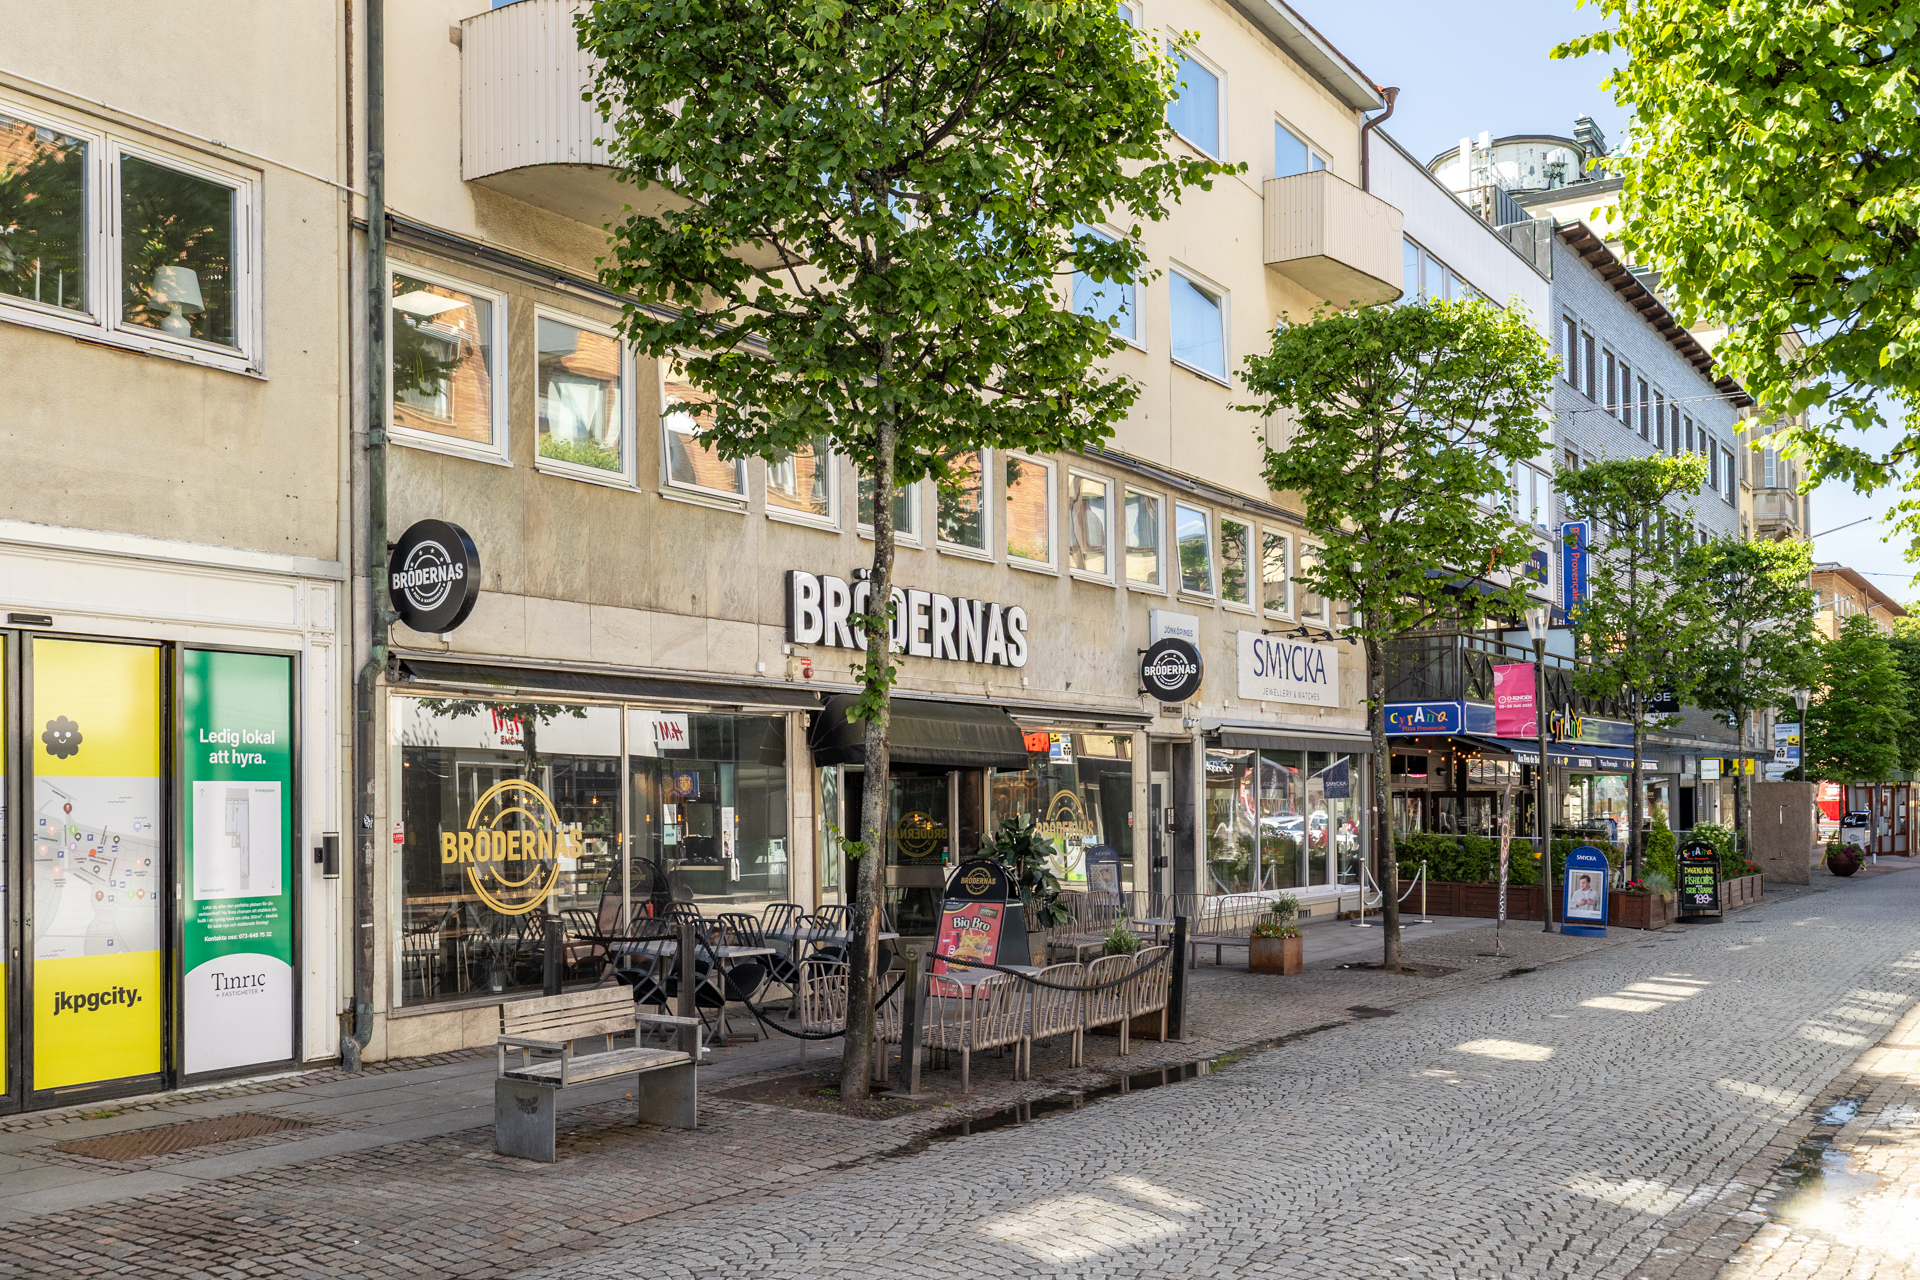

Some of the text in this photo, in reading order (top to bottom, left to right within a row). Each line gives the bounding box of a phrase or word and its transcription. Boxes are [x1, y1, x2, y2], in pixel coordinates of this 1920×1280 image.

[392, 562, 464, 590] BRÖDERNAS
[1571, 552, 1580, 602] Provençale
[1164, 625, 1193, 637] JÖNKÖPINGS
[1144, 664, 1197, 676] BRÖDERNAS
[1253, 638, 1327, 685] SMYCKA
[1263, 687, 1292, 698] JEWELLERY
[1298, 692, 1320, 701] WATCHES
[200, 728, 275, 747] Ledig lokal
[209, 749, 266, 768] att hyra.
[1036, 819, 1094, 840] BRÖDERNAS
[442, 825, 583, 864] BRÖDERNAS
[960, 876, 996, 885] BRÖDERNAS
[952, 916, 970, 930] Big
[971, 917, 991, 932] Bro
[53, 986, 142, 1016] jkpgcity.
[222, 989, 259, 997] FASTIGHETER
